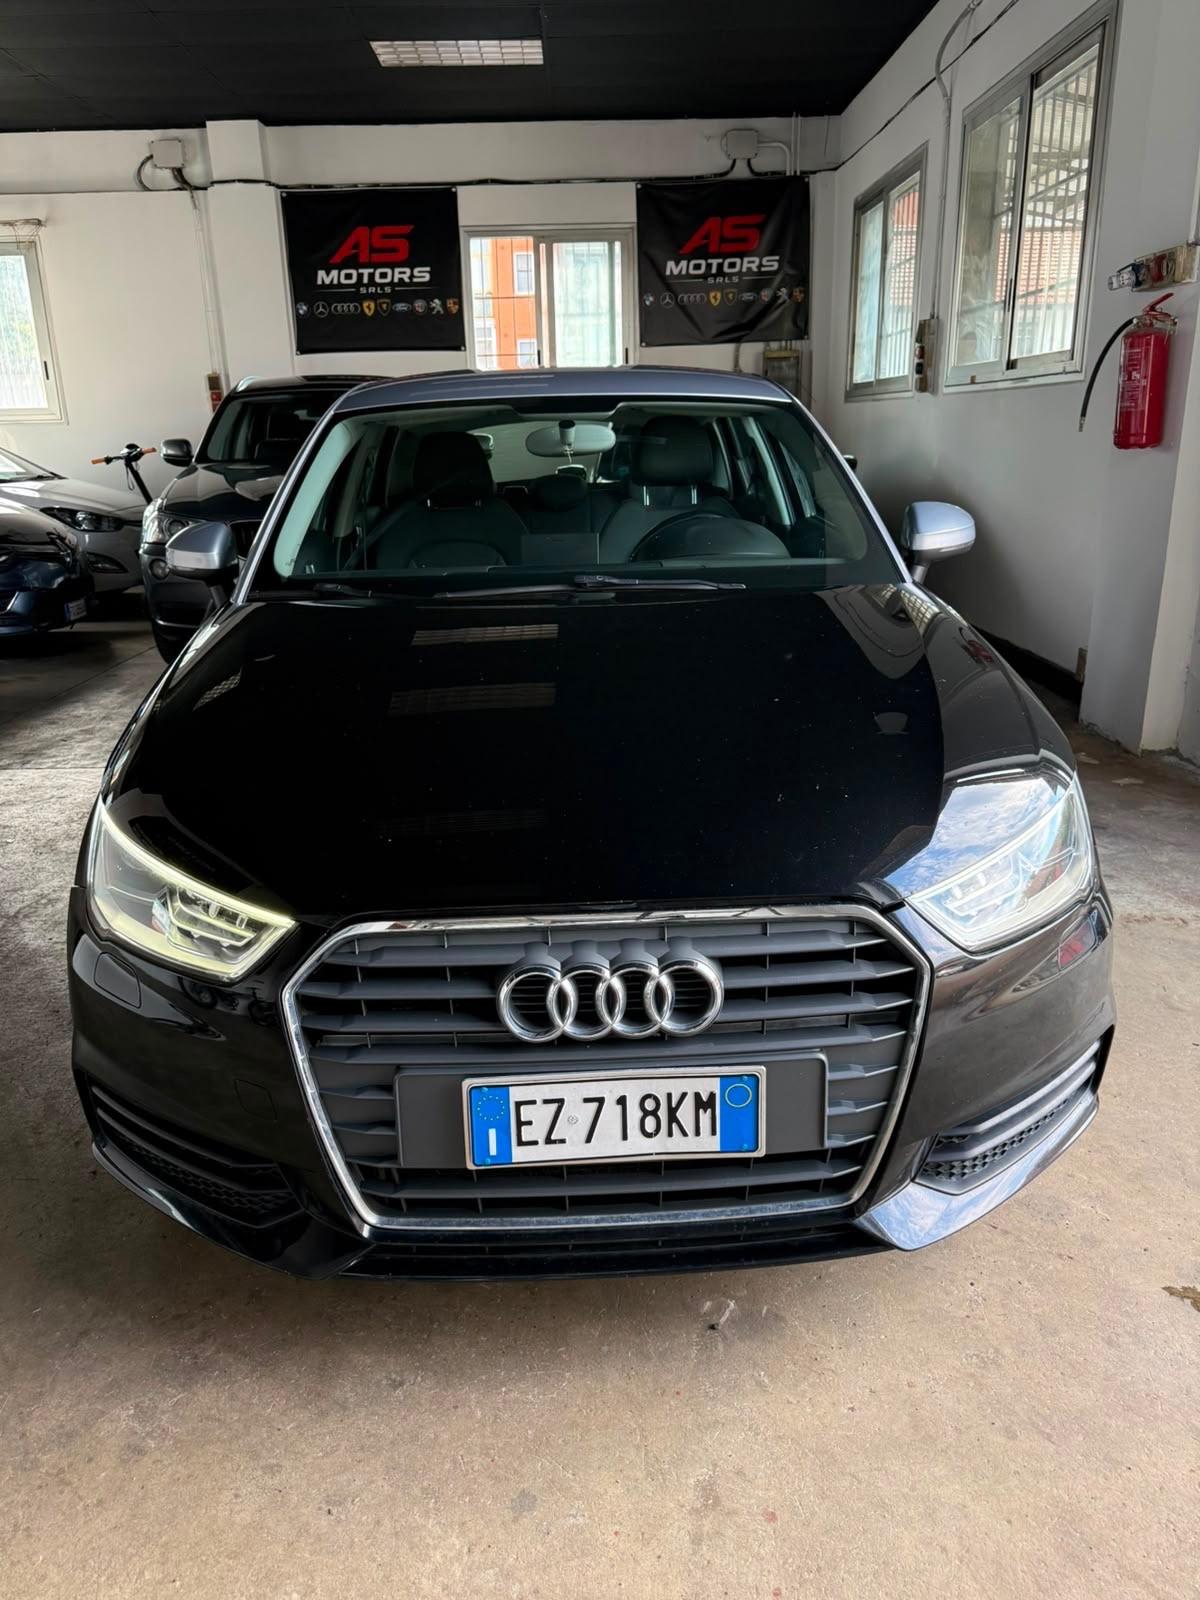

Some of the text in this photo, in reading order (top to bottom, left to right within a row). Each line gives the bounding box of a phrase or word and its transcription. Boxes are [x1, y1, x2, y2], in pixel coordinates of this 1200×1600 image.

[679, 215, 766, 255] AS
[329, 225, 414, 264] AS
[665, 256, 780, 275] MOTORS
[316, 267, 431, 285] MOTORS
[707, 276, 739, 284] SRLS
[360, 286, 392, 294] SRLS
